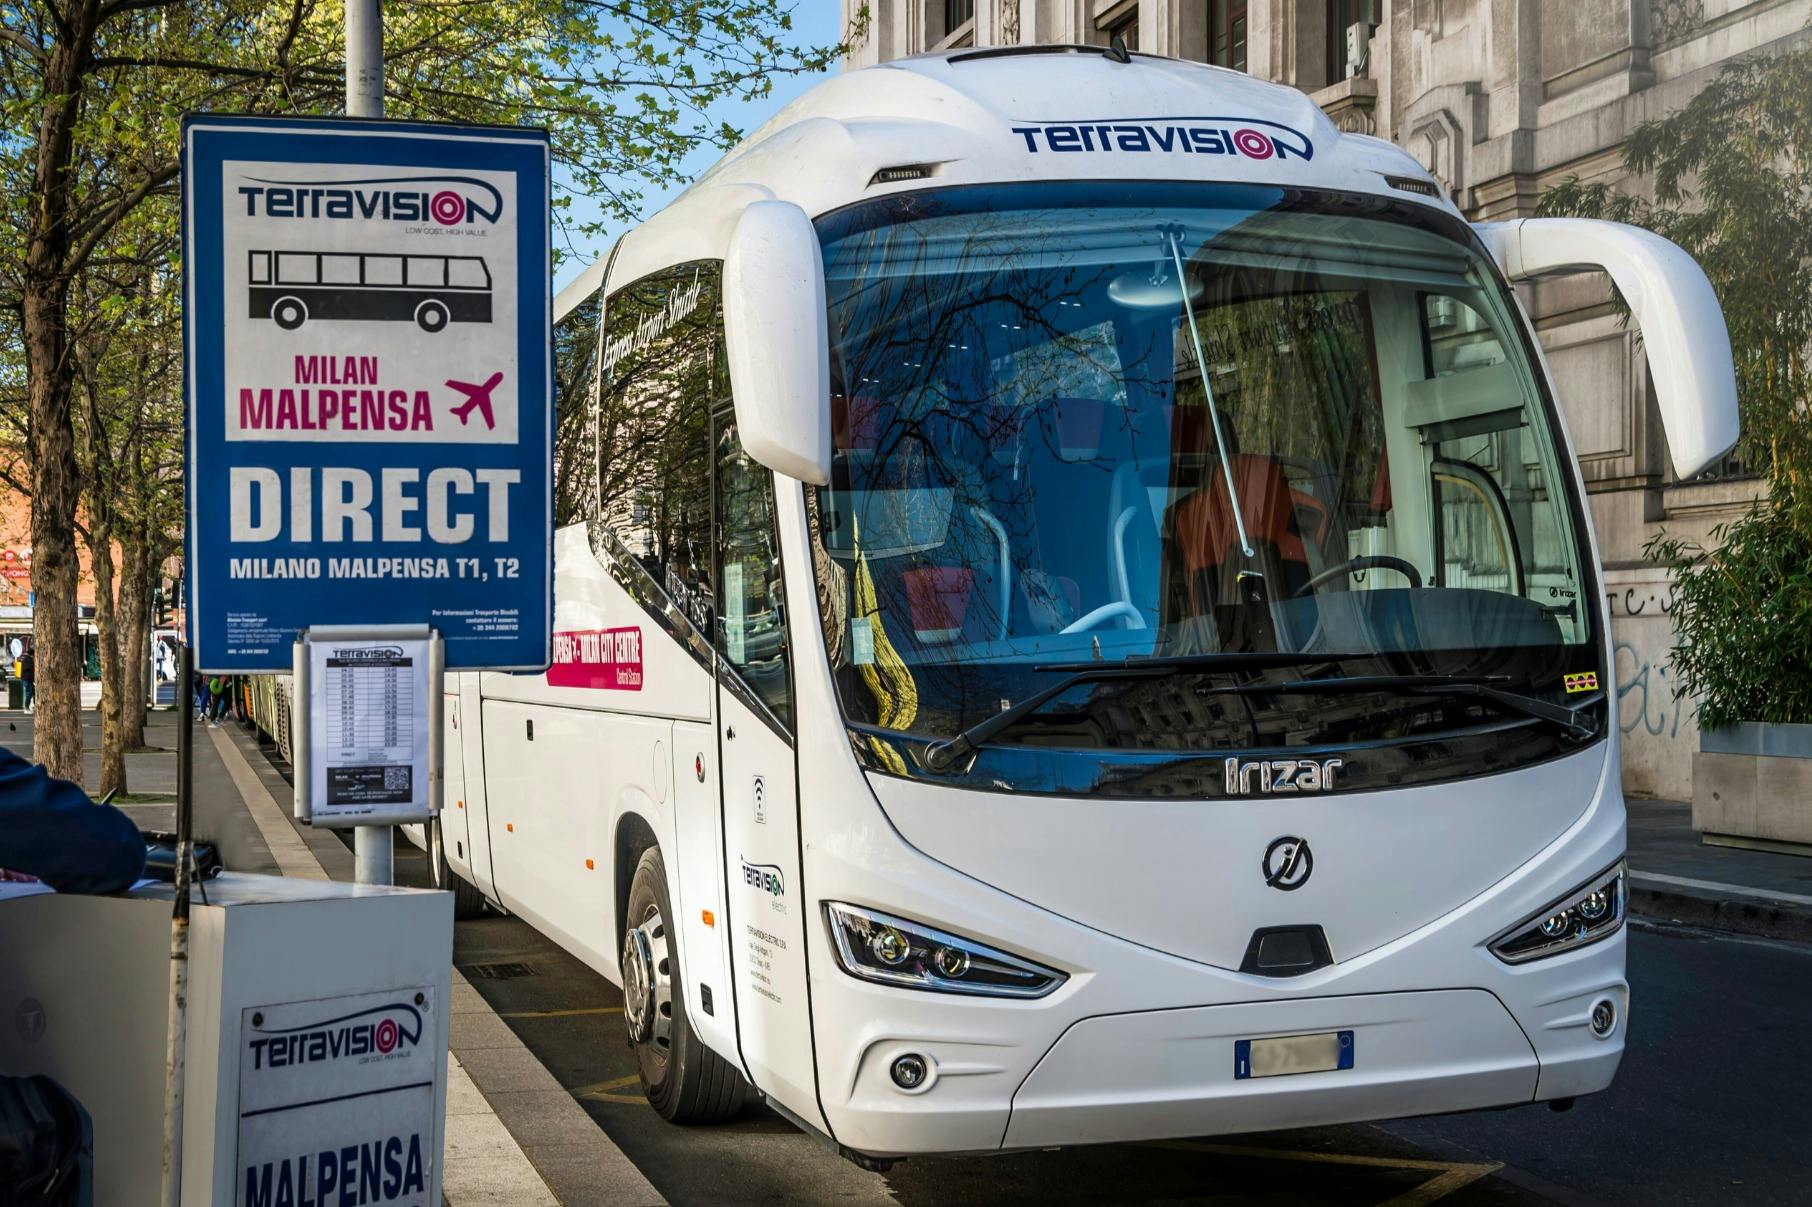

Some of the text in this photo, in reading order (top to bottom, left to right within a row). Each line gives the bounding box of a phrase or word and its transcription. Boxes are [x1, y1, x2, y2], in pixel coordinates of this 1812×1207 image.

[602, 268, 700, 378] Express Airport Shuttle
[294, 355, 378, 385] MILAN
[239, 388, 434, 431] MALPENSA
[230, 466, 521, 544] DIRECT
[230, 558, 520, 582] MILANO MALPENSA T1, T2
[580, 634, 600, 664] MILAN
[601, 632, 614, 664] CITY
[615, 630, 640, 664] CENTRE
[1225, 757, 1342, 794] Irizar
[245, 1133, 424, 1207] MALPENSA
